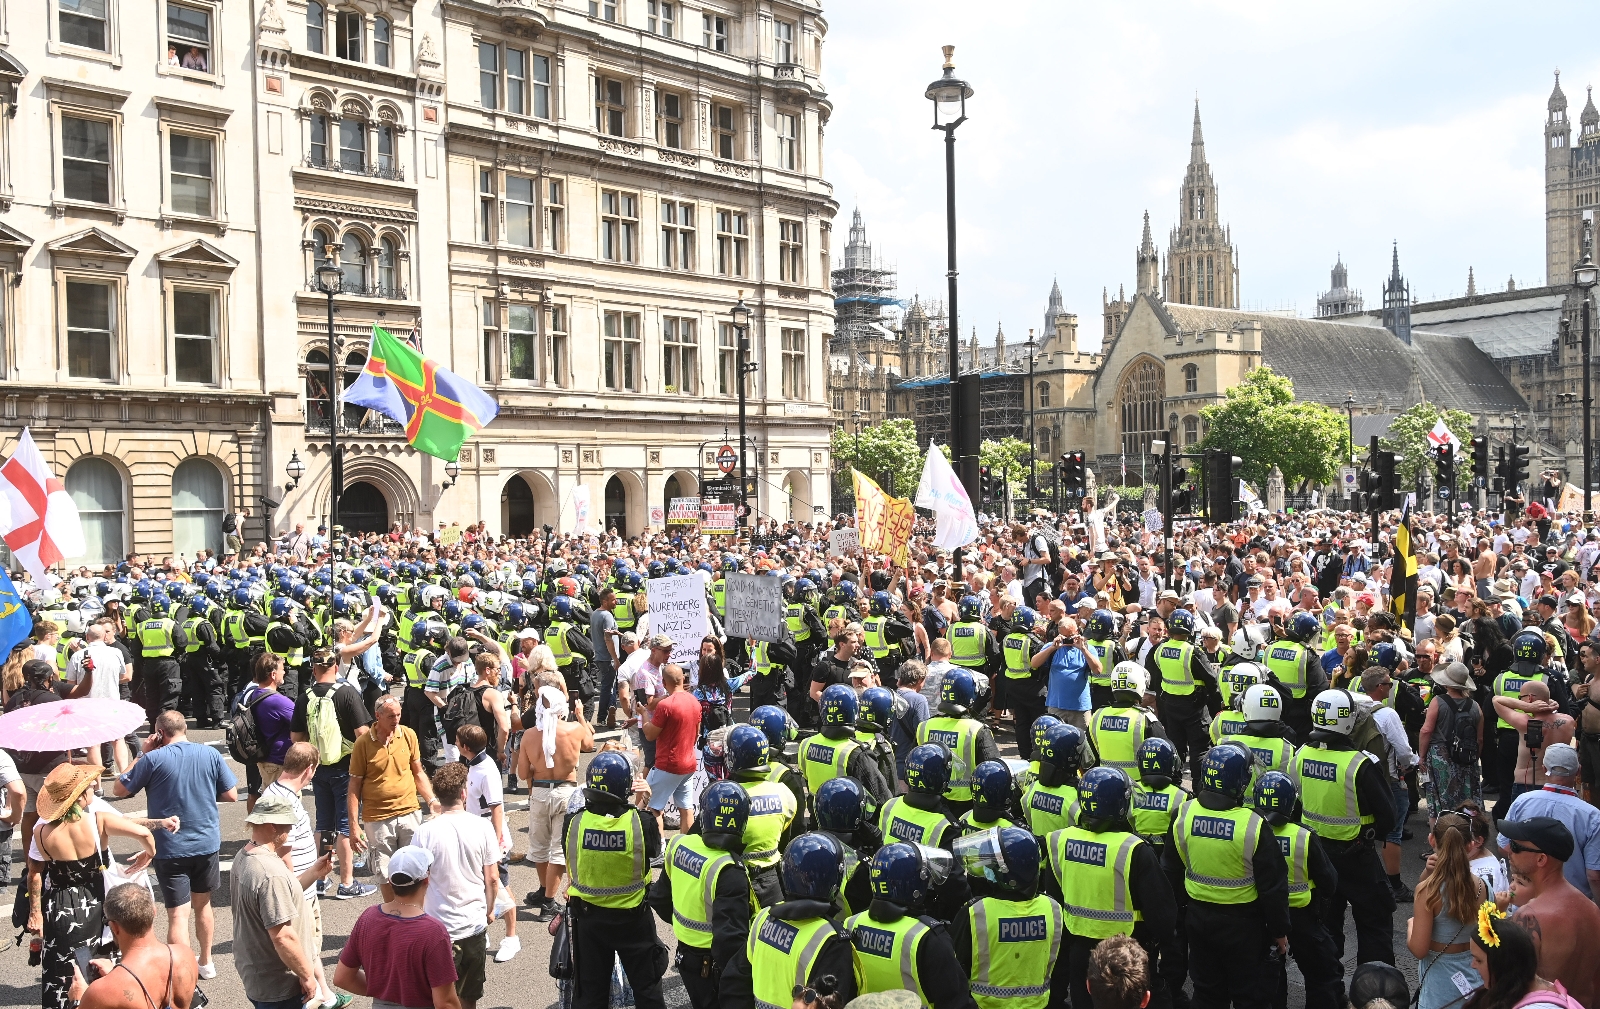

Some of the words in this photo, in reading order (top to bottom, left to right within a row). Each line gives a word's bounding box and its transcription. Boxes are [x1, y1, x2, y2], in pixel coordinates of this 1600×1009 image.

[648, 599, 700, 614] NUREMBERG
[745, 595, 774, 614] GENETIC
[730, 608, 759, 622] THERAPY
[657, 620, 692, 634] NAZIS
[955, 628, 974, 637] POLICE
[1006, 639, 1022, 649] POLICE
[1161, 648, 1180, 658] POLICE
[1271, 649, 1296, 660] POLICE
[941, 692, 955, 701] CE
[1261, 699, 1279, 707] EA
[826, 714, 844, 722] CE
[1338, 708, 1350, 717] EG
[1102, 717, 1128, 730] POLICE
[929, 732, 957, 745] POLICE
[807, 746, 833, 762] POLICE
[1142, 761, 1161, 770] EA
[1303, 762, 1335, 778] POLICE
[1207, 768, 1219, 777] MP
[908, 778, 926, 789] EA
[1204, 776, 1223, 789] NE
[1081, 790, 1093, 799] MP
[750, 798, 782, 812] POLICE
[1032, 793, 1061, 812] POLICE
[1080, 801, 1098, 812] KF
[1260, 797, 1279, 807] NE
[720, 805, 734, 814] MP
[714, 816, 737, 828] EA
[1193, 819, 1232, 837] POLICE
[891, 821, 922, 841] POLICE
[584, 832, 624, 848] POLICE
[1066, 841, 1104, 862] POLICE
[674, 848, 704, 874] POLICE
[871, 868, 882, 878] MP
[761, 920, 794, 949] POLICE
[1001, 920, 1045, 939] POLICE
